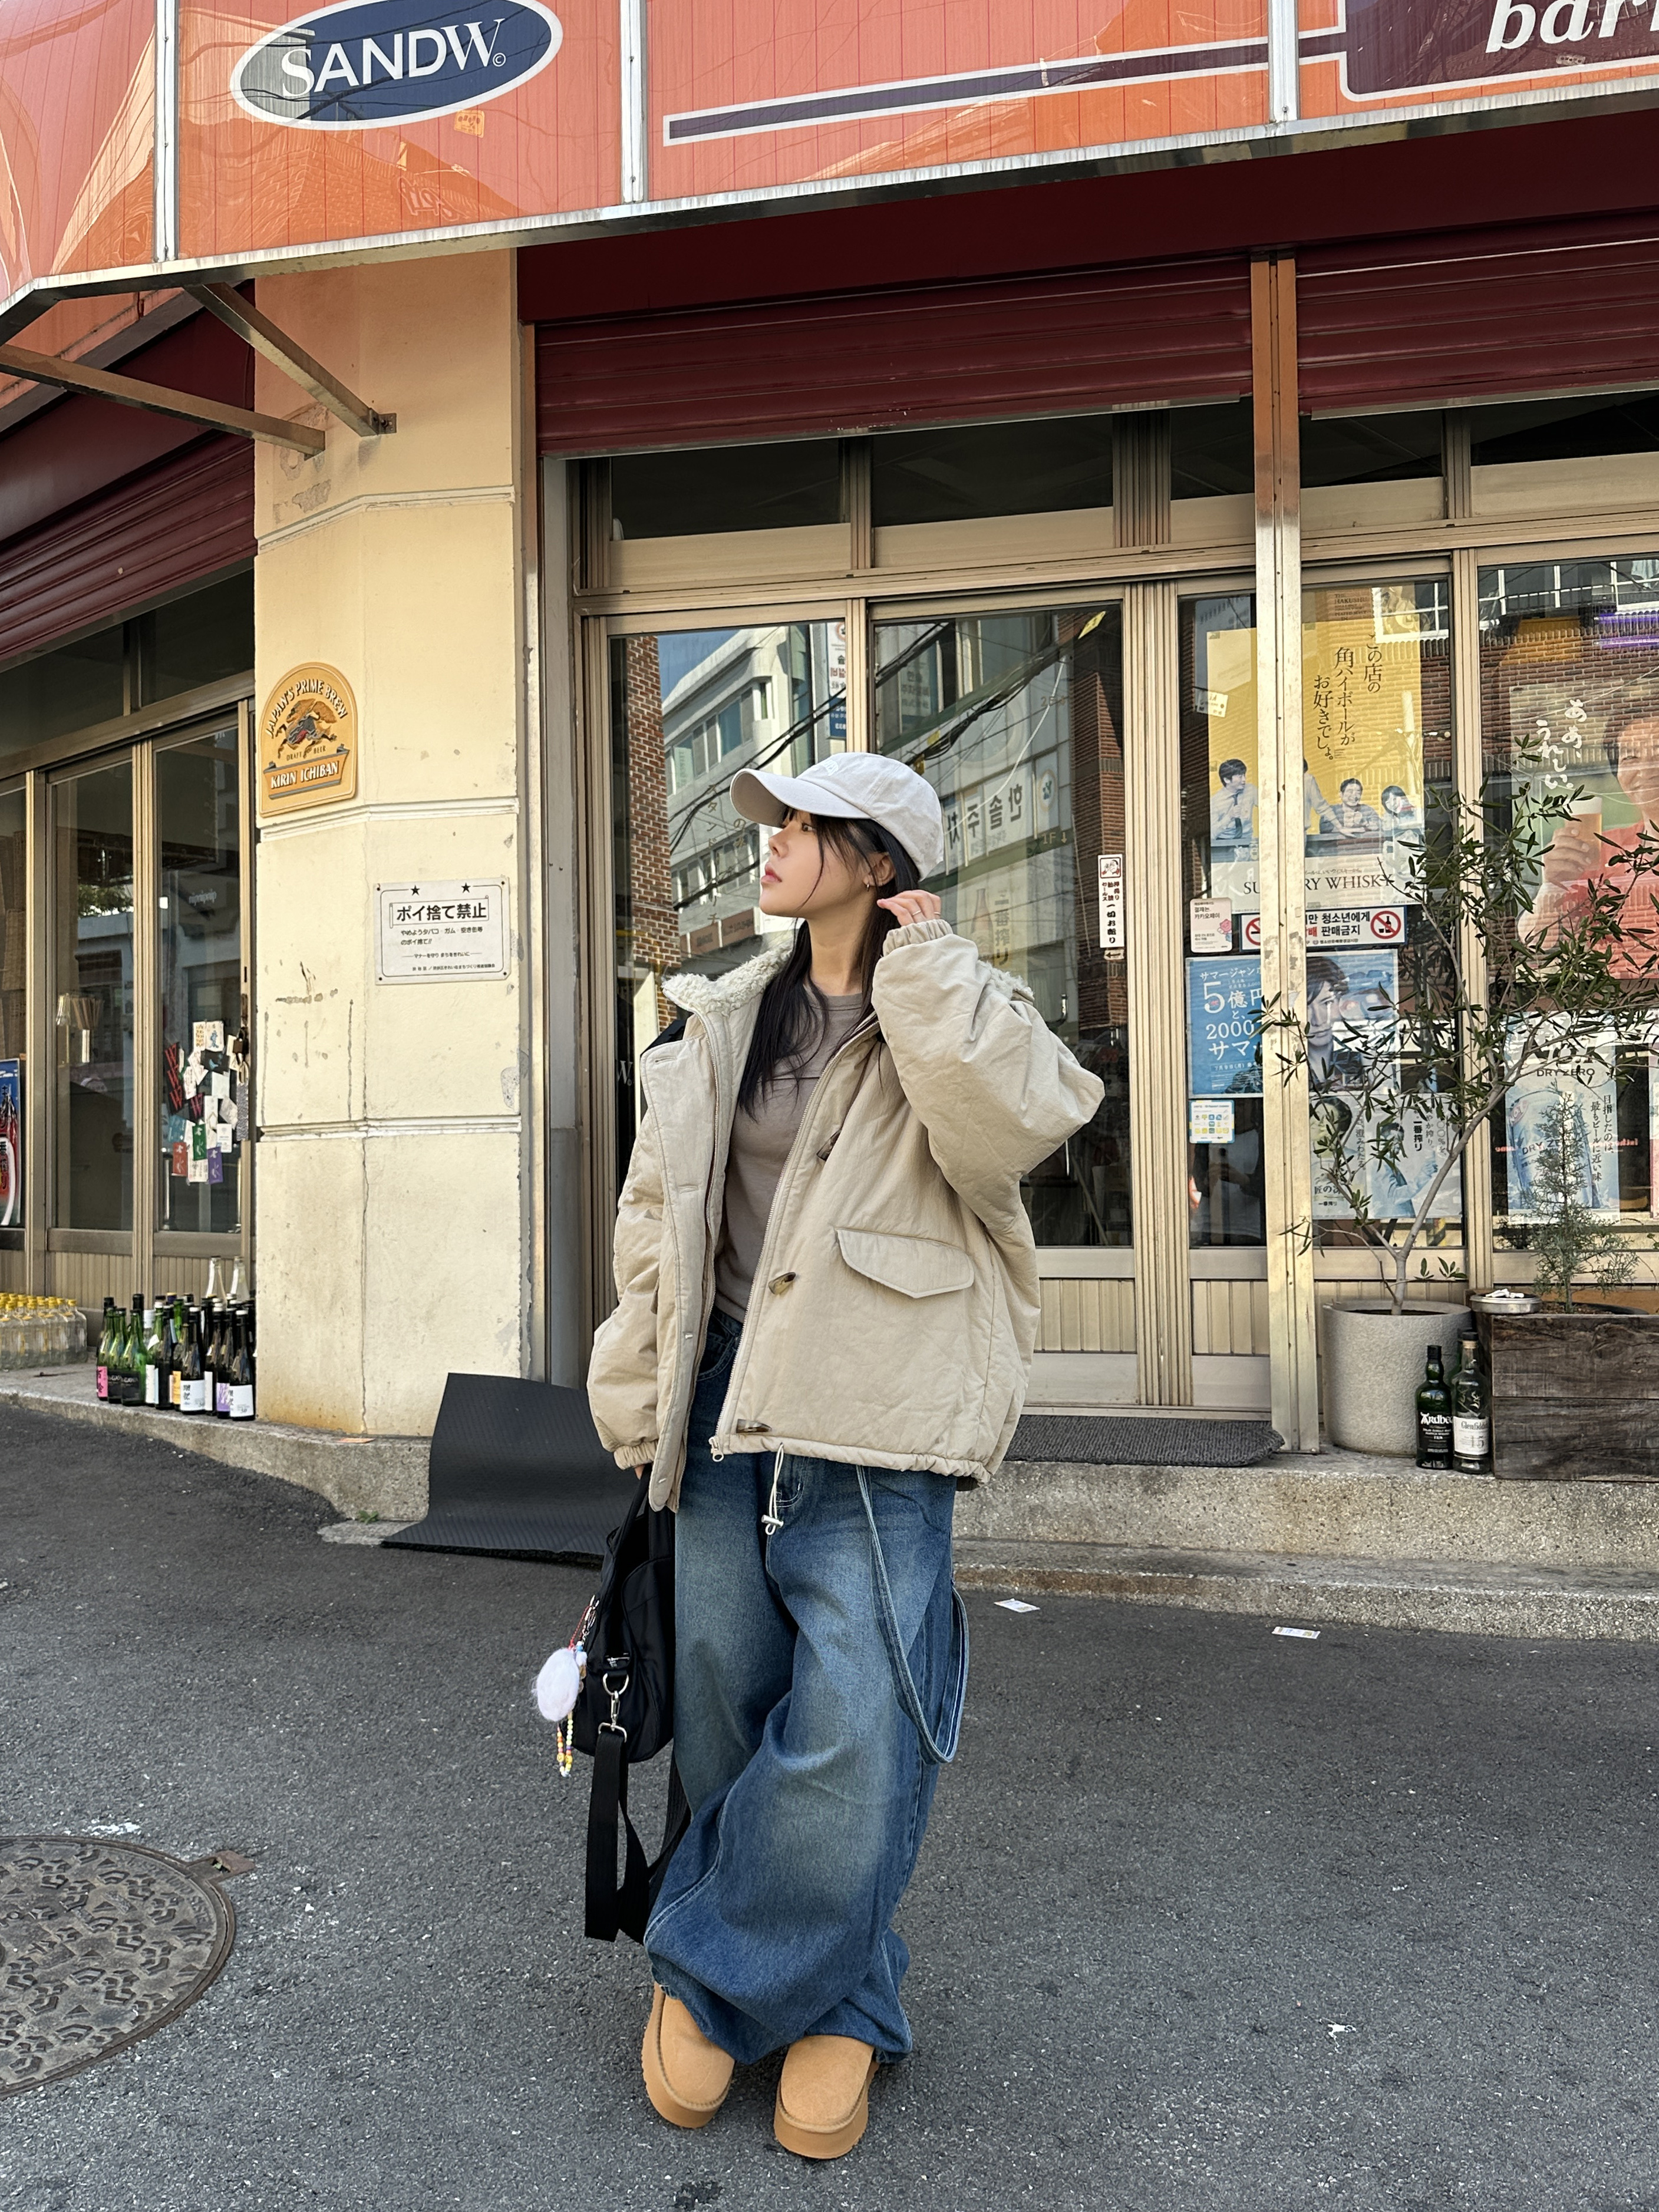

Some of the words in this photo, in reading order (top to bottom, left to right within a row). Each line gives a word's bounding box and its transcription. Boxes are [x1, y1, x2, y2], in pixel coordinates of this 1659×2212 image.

[1485, 0, 1659, 54] bar
[1364, 634, 1383, 694] この店の
[265, 686, 295, 739] JAPAN'S
[295, 679, 324, 696] PRIME
[324, 684, 348, 719] BREW
[1313, 675, 1334, 760] お好きでしょ。
[1334, 646, 1355, 746] 角ハイボールが
[271, 770, 297, 790] KIRIN
[300, 760, 339, 783] ICHIBAN
[286, 751, 302, 761] DRAFT
[313, 745, 326, 754] BEER
[1536, 719, 1574, 790] うれしい。
[1325, 873, 1393, 889] WHISKY
[397, 902, 487, 922] ポイ捨て禁止
[1305, 913, 1318, 925] 만
[1321, 911, 1370, 924] 청소년에게
[1305, 926, 1317, 937] 배
[1321, 925, 1360, 937] 판매금지
[1591, 1101, 1602, 1182] 最もビールに近い味
